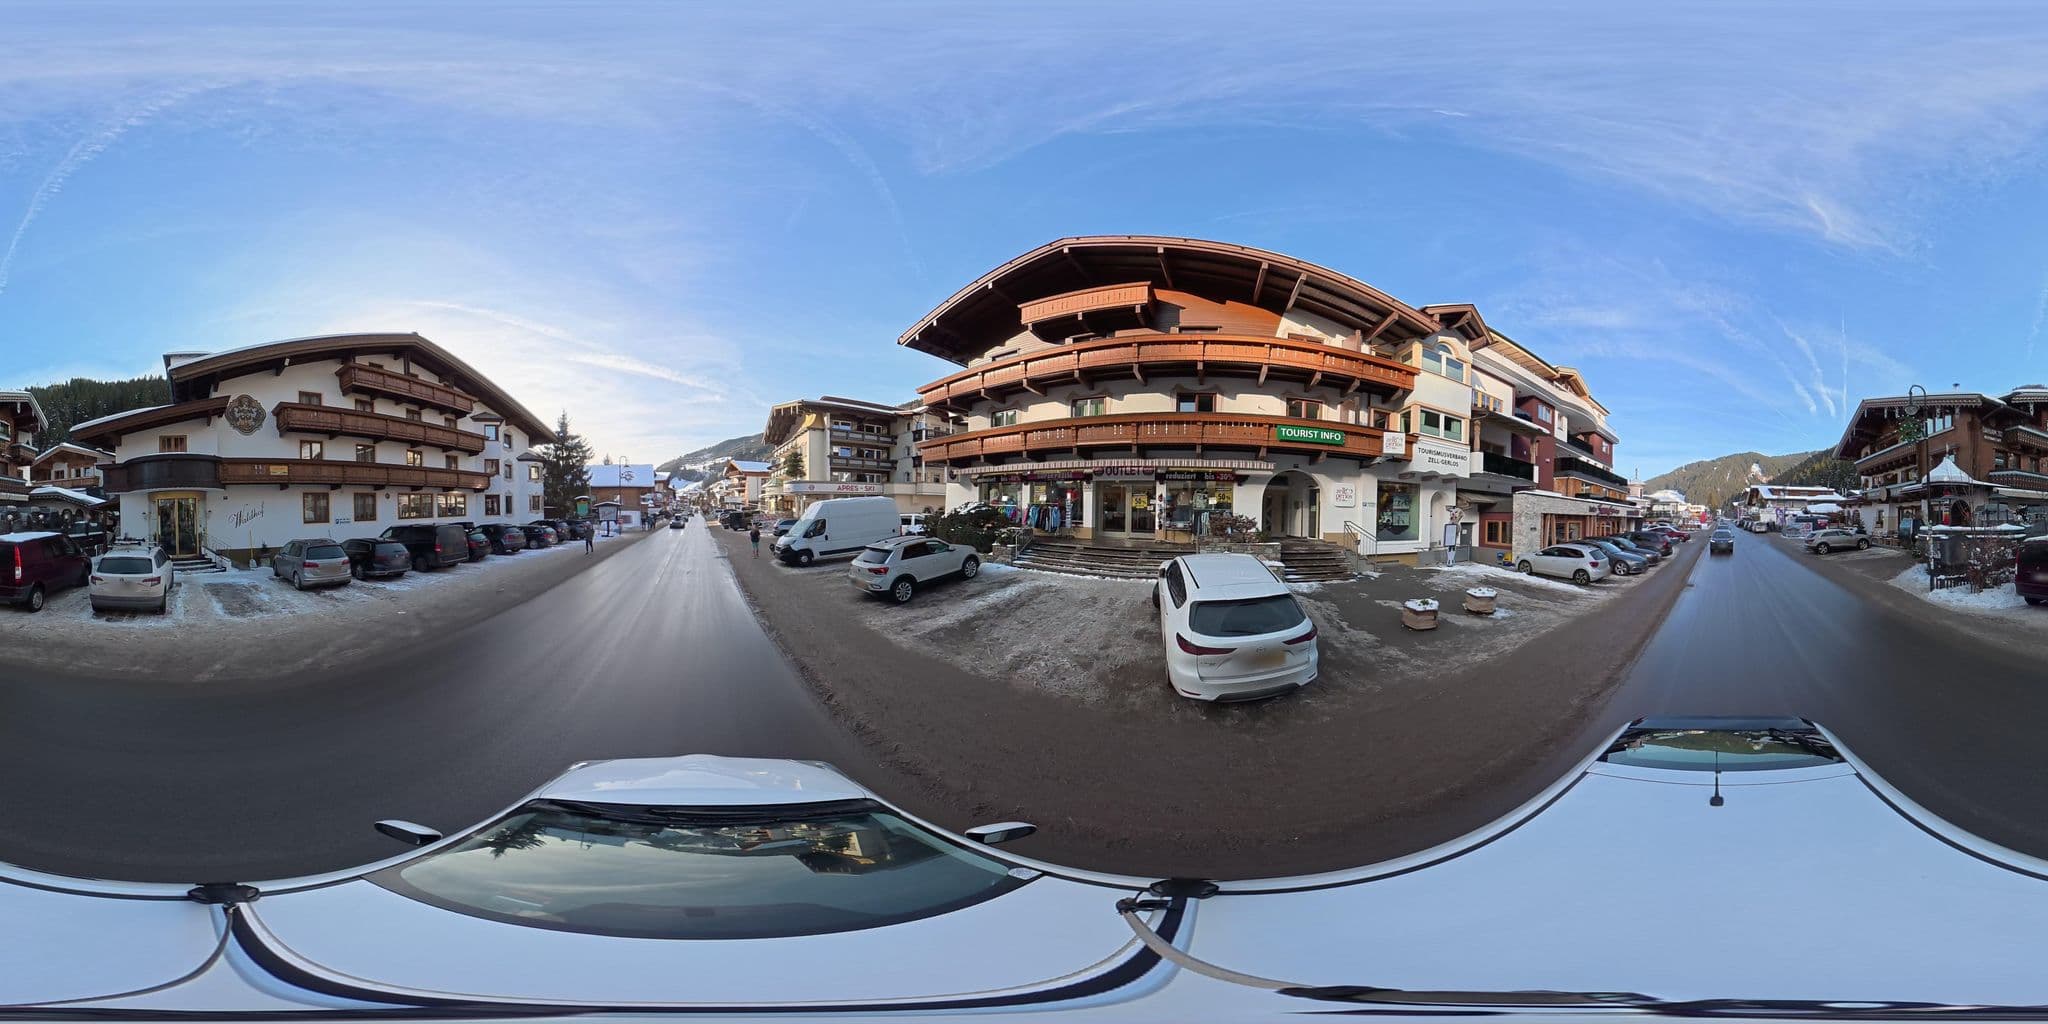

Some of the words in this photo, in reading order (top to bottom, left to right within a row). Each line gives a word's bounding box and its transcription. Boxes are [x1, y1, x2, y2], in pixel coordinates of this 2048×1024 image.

[1281, 428, 1319, 439] TOURIST
[1320, 432, 1341, 441] INFO
[1418, 447, 1468, 461] TOURISMUSVERBAND
[1428, 457, 1459, 467] ZELL-GERLOS
[1105, 466, 1142, 476] OUTLET
[1204, 472, 1215, 480] bis
[228, 500, 264, 528] Waldhof
